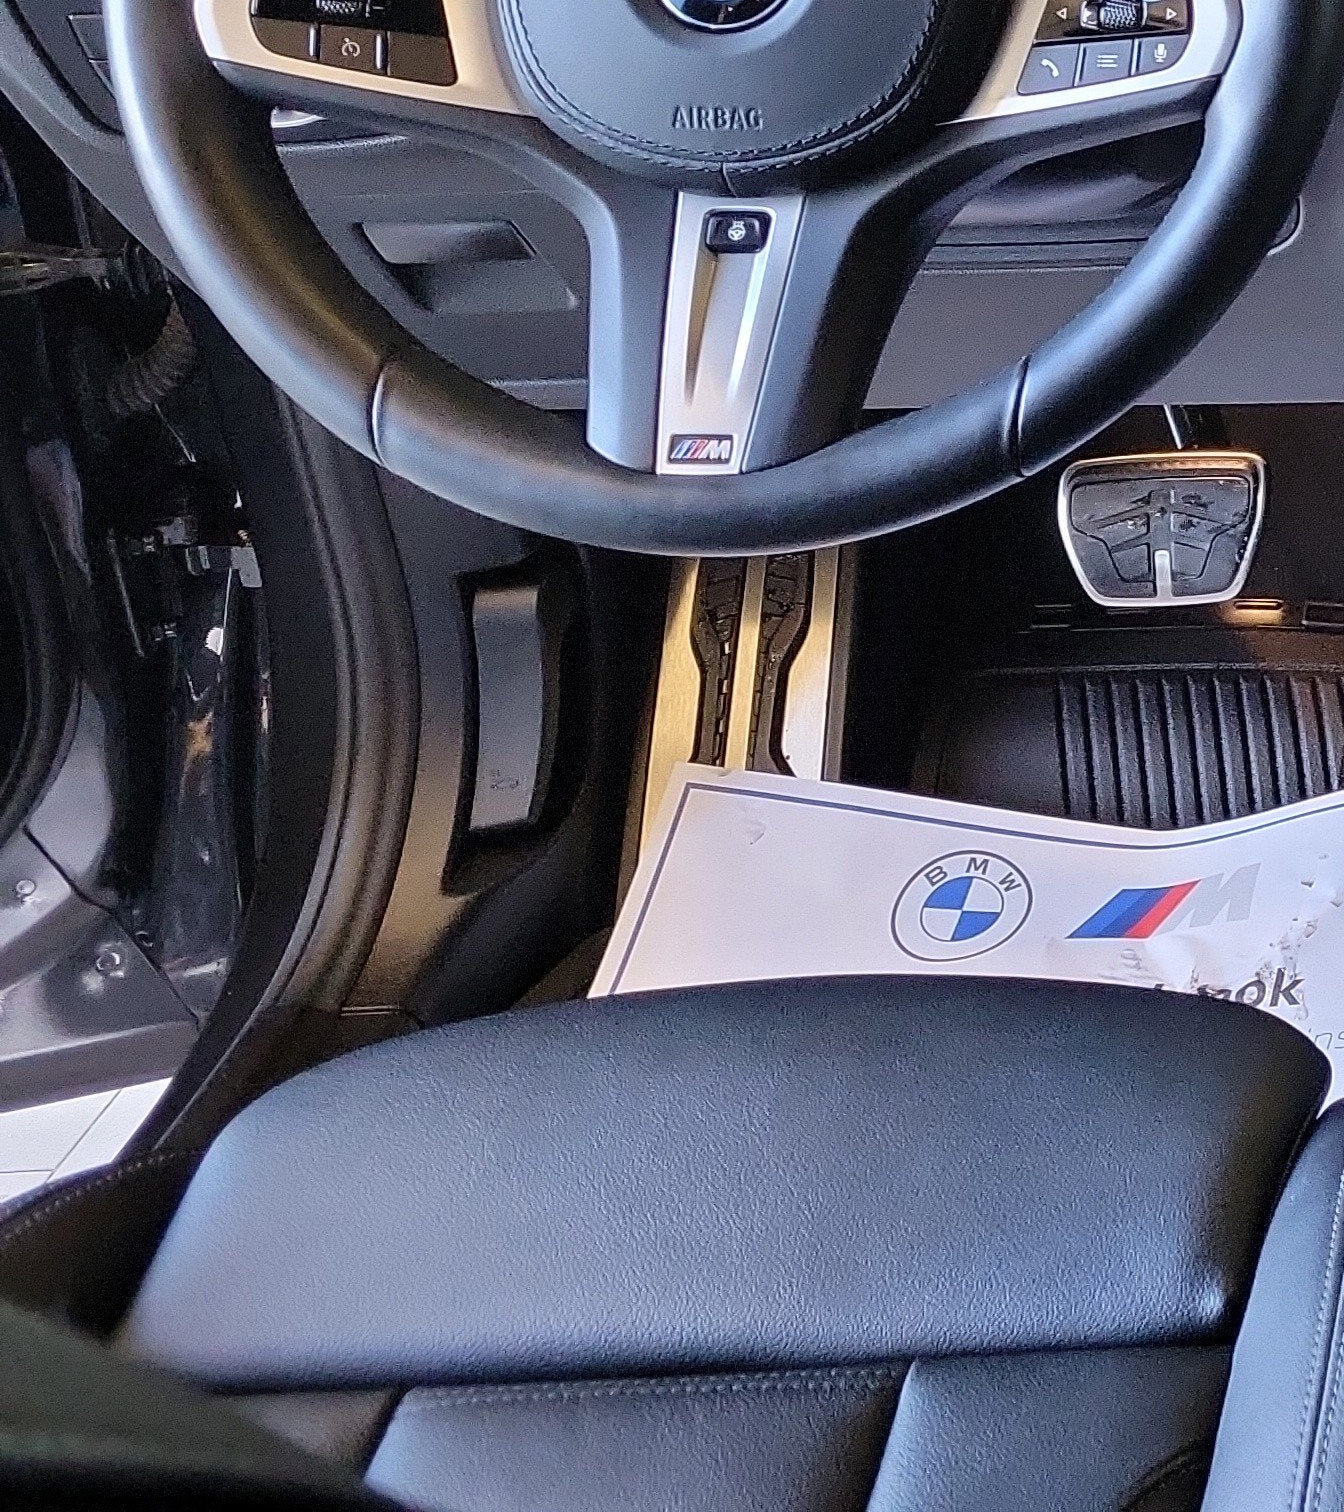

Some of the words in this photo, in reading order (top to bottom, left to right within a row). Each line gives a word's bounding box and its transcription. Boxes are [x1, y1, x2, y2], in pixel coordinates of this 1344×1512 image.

[671, 104, 764, 131] AIRBAG
[923, 857, 1023, 893] BMW
[1152, 863, 1262, 936] M
